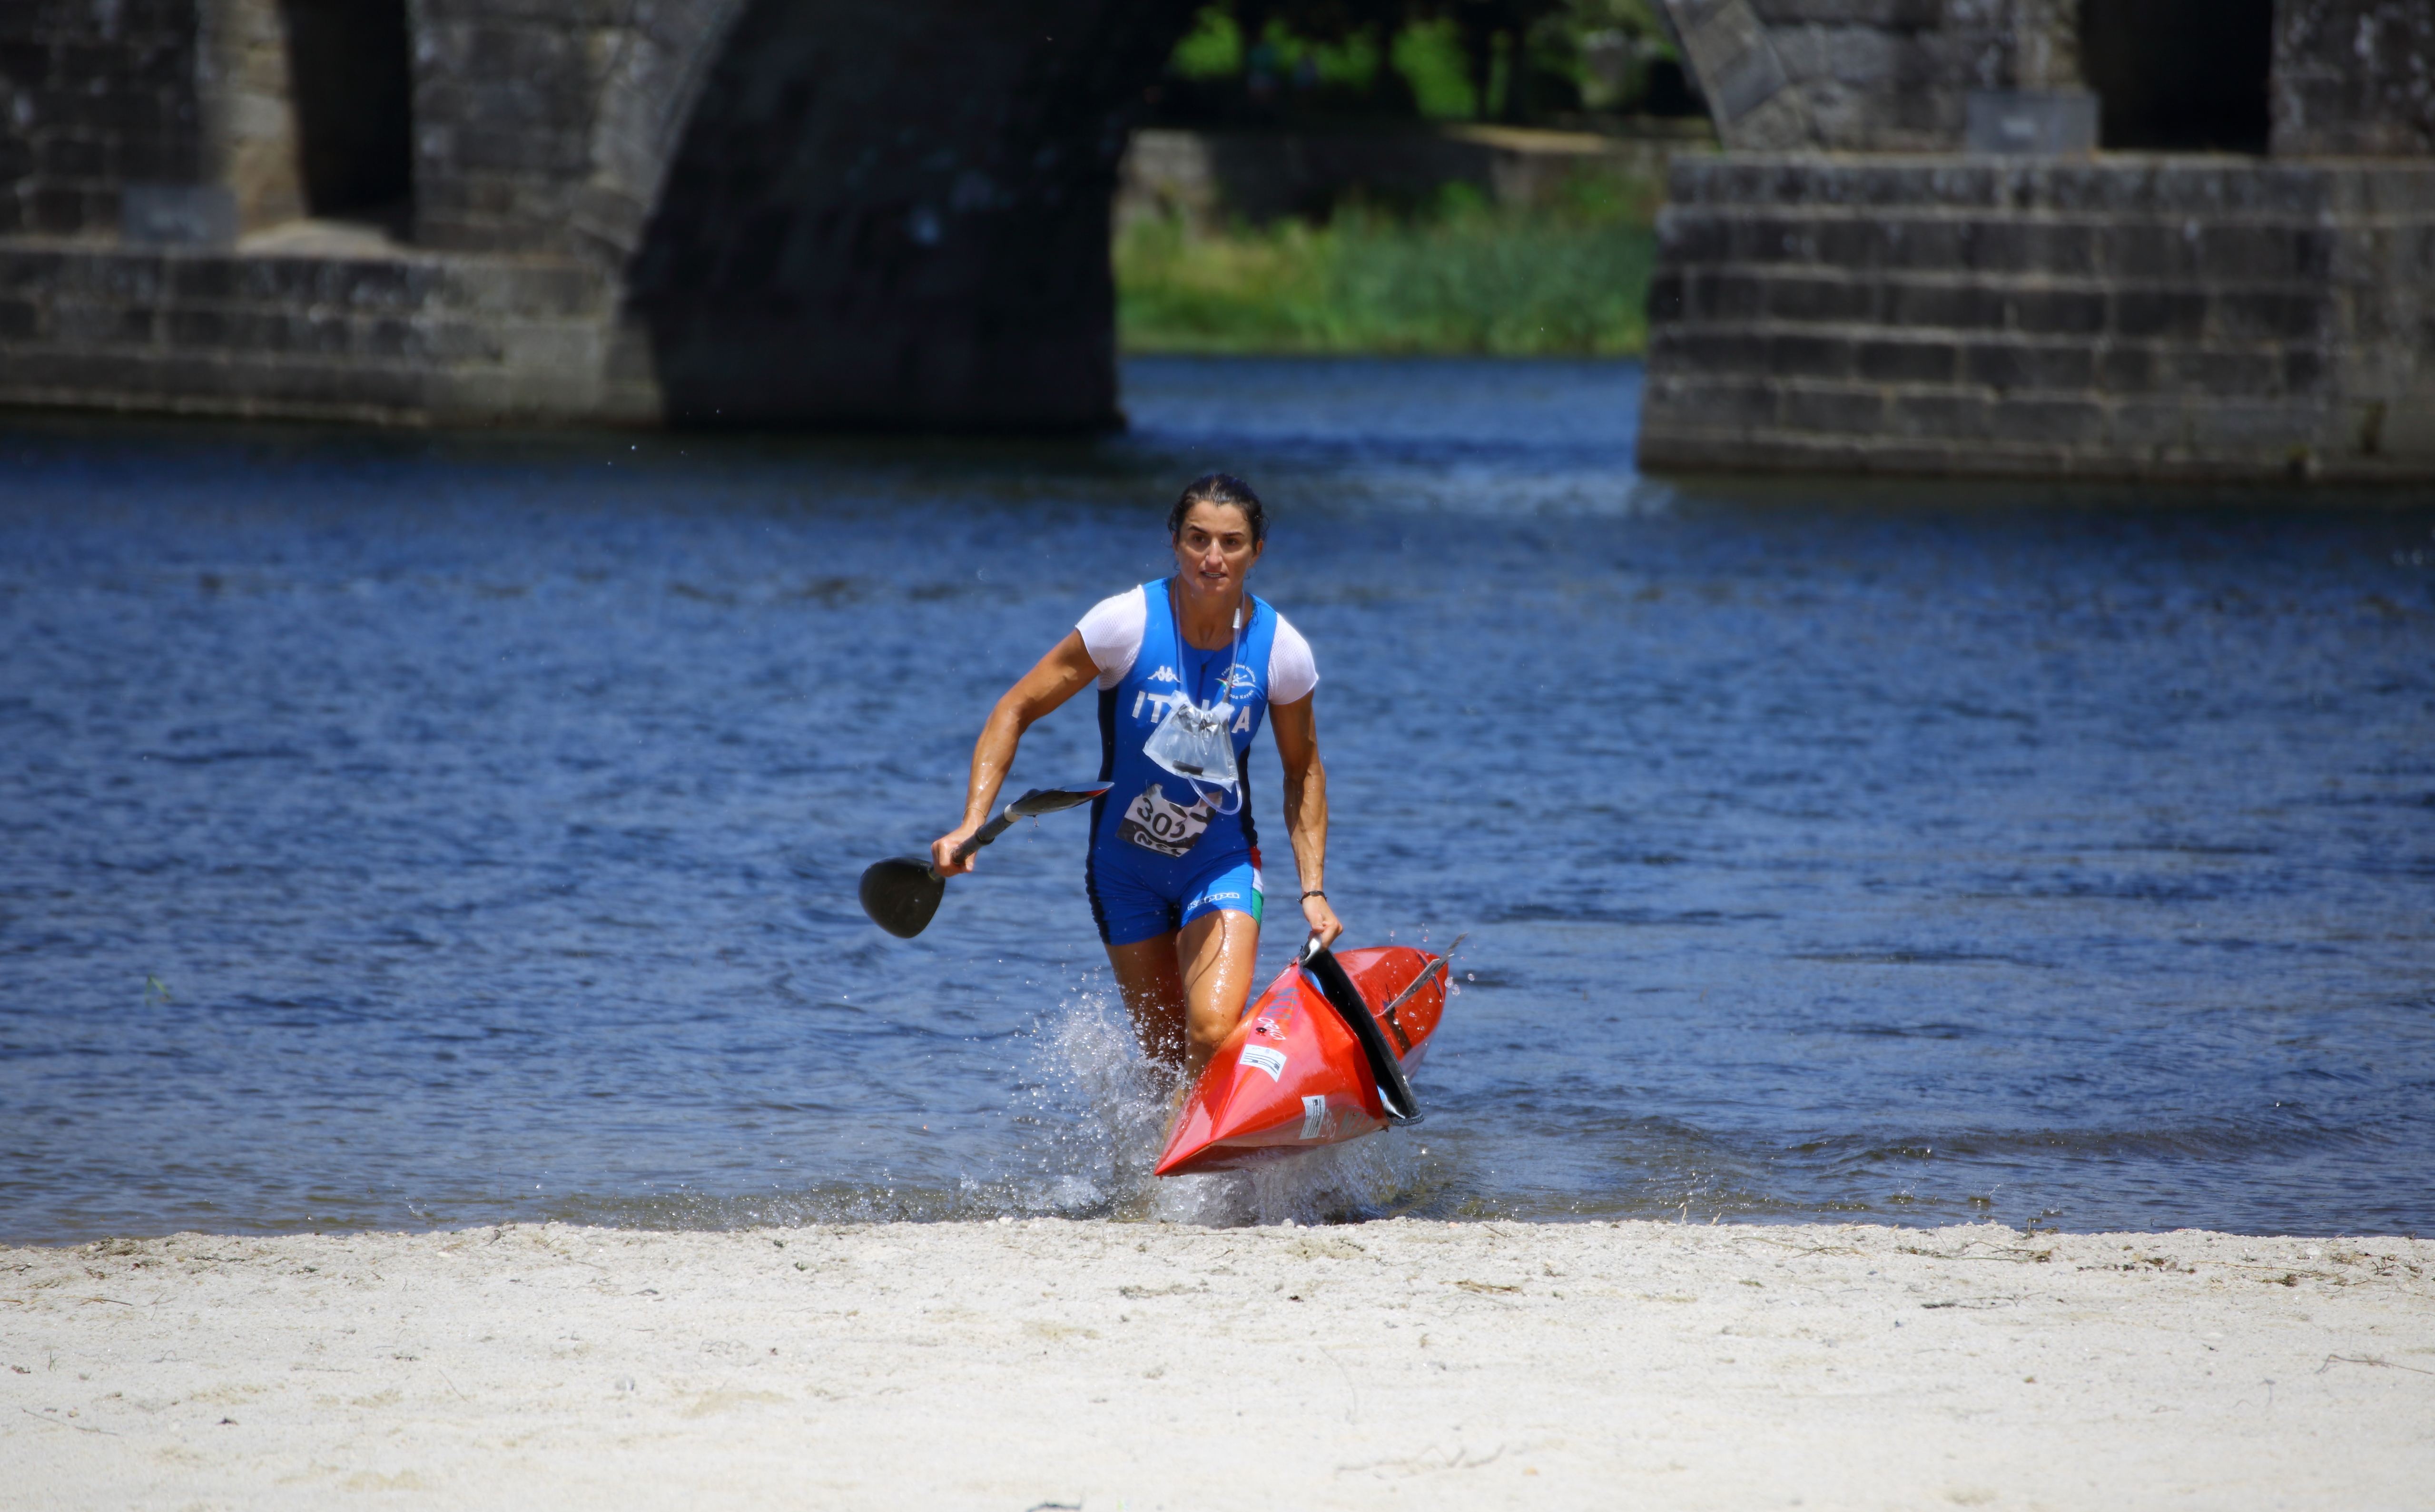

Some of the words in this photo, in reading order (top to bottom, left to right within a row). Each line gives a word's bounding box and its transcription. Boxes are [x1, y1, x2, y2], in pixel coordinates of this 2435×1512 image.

[1240, 690, 1254, 699] Kayak
[1132, 690, 1250, 734] ITA
[1187, 893, 1240, 911] Kappa
